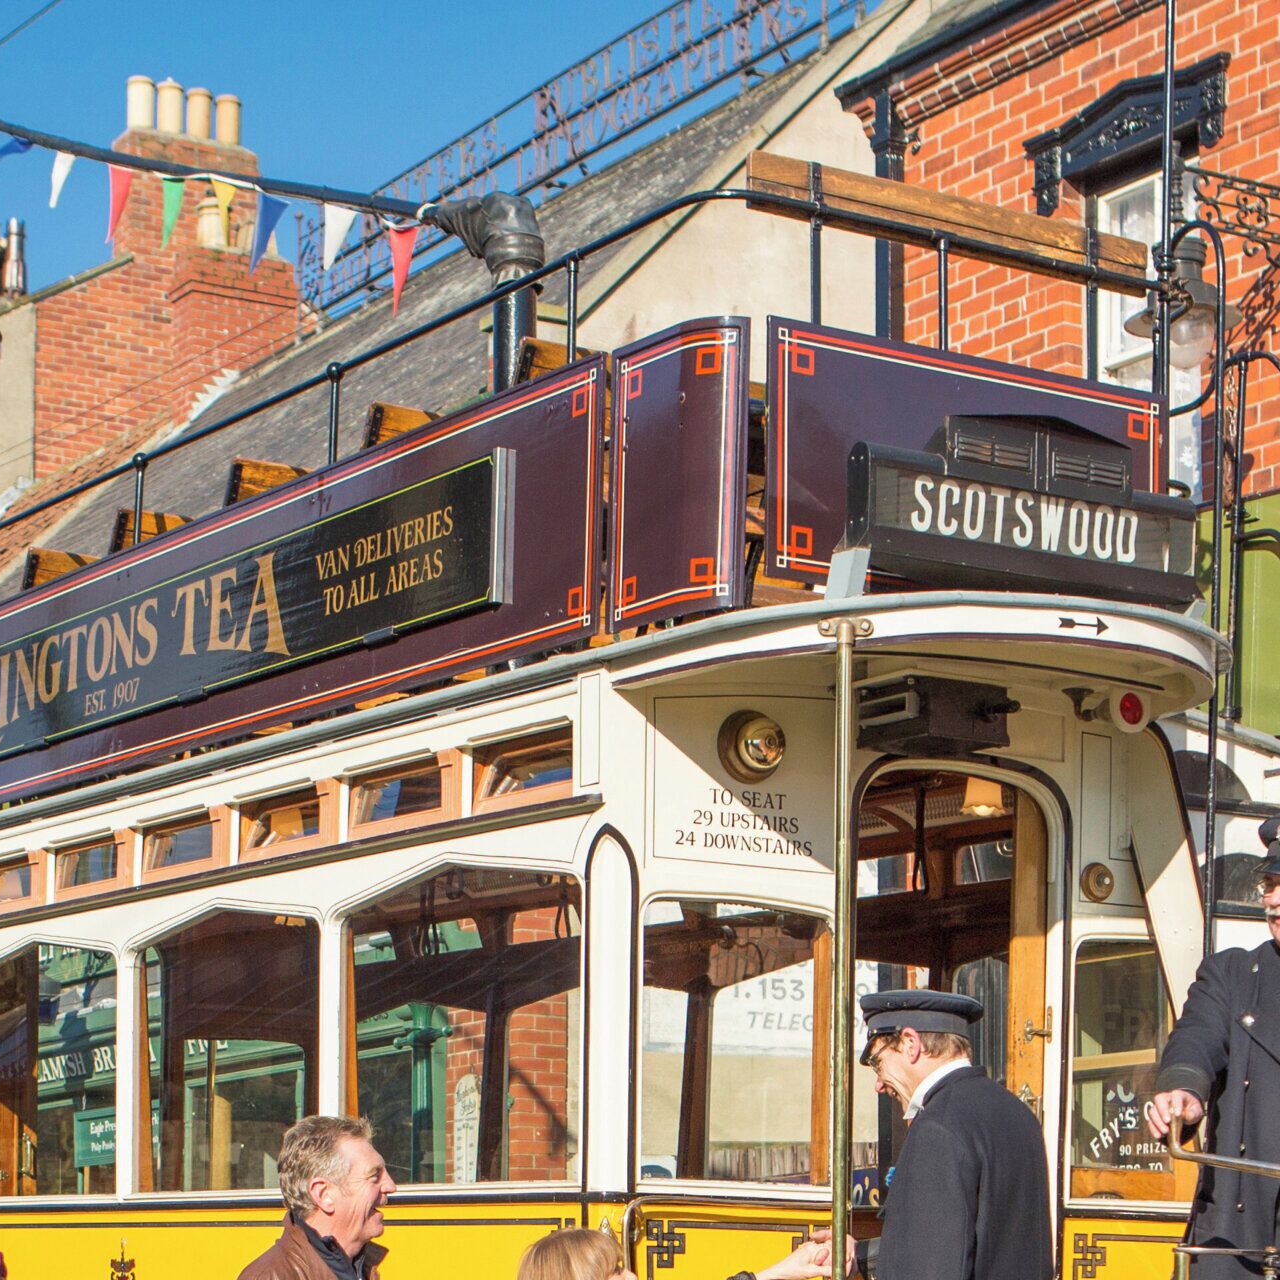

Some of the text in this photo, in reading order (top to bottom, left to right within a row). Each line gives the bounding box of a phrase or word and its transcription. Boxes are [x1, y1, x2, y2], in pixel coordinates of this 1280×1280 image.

[910, 475, 1139, 565] SCOTSWOOD
[315, 506, 454, 580] VAN DELIVERIES
[171, 551, 291, 655] TEA
[323, 549, 443, 616] TO ALL AREAS
[84, 677, 140, 716] EST. 1907
[709, 788, 786, 810] TO SEAT
[675, 829, 813, 857] 24 DOWNSTAIRS
[693, 809, 799, 834] 29 UPSTAIRS
[1090, 1109, 1136, 1159] FRY'S
[1119, 1142, 1167, 1156] 90 PRIZE
